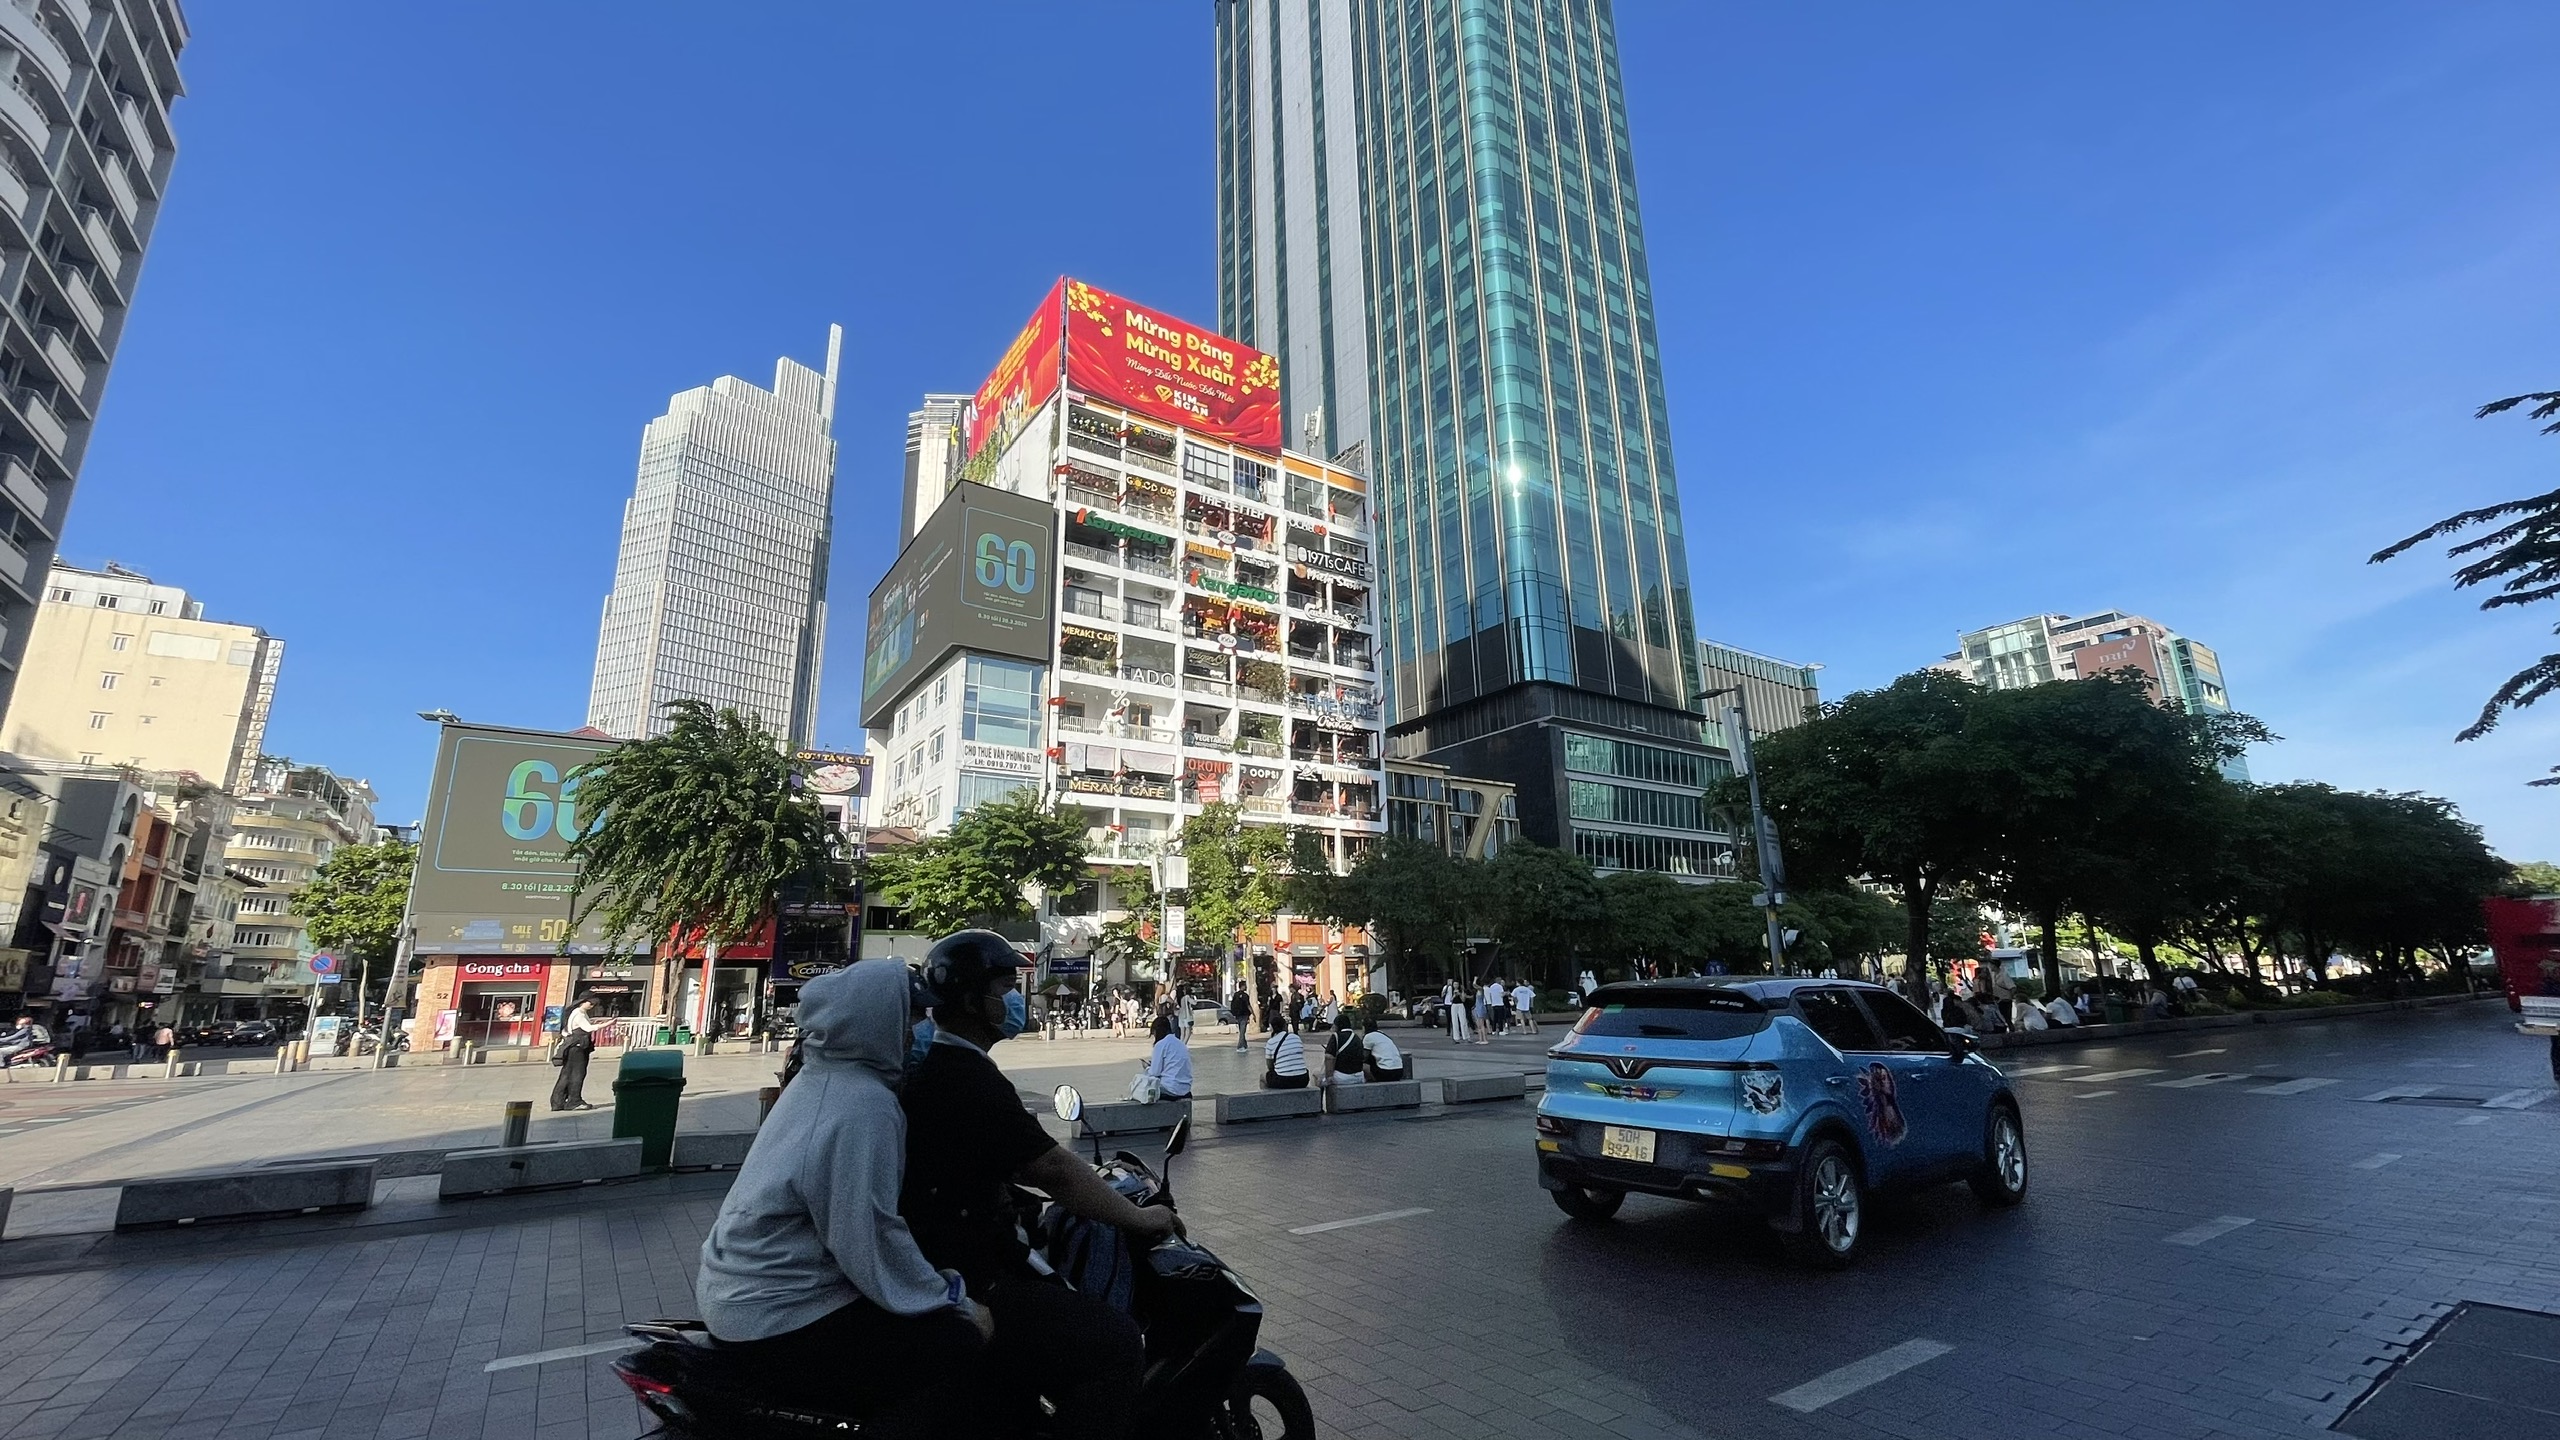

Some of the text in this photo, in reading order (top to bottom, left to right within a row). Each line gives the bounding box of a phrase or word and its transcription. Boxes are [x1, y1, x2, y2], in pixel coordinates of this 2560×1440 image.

[1125, 309, 1234, 368] Mừng Đảng
[1126, 332, 1235, 387] Mừng Xuân
[1173, 389, 1197, 405] KIM
[1076, 508, 1168, 548] Kangaroo
[975, 533, 1036, 594] 60
[1061, 625, 1095, 639] MERAKI
[845, 756, 870, 765] CLI
[1249, 767, 1280, 780] OOPS!
[1069, 779, 1123, 794] MERAKI
[512, 925, 532, 935] SALE
[465, 962, 530, 976] Gong cha
